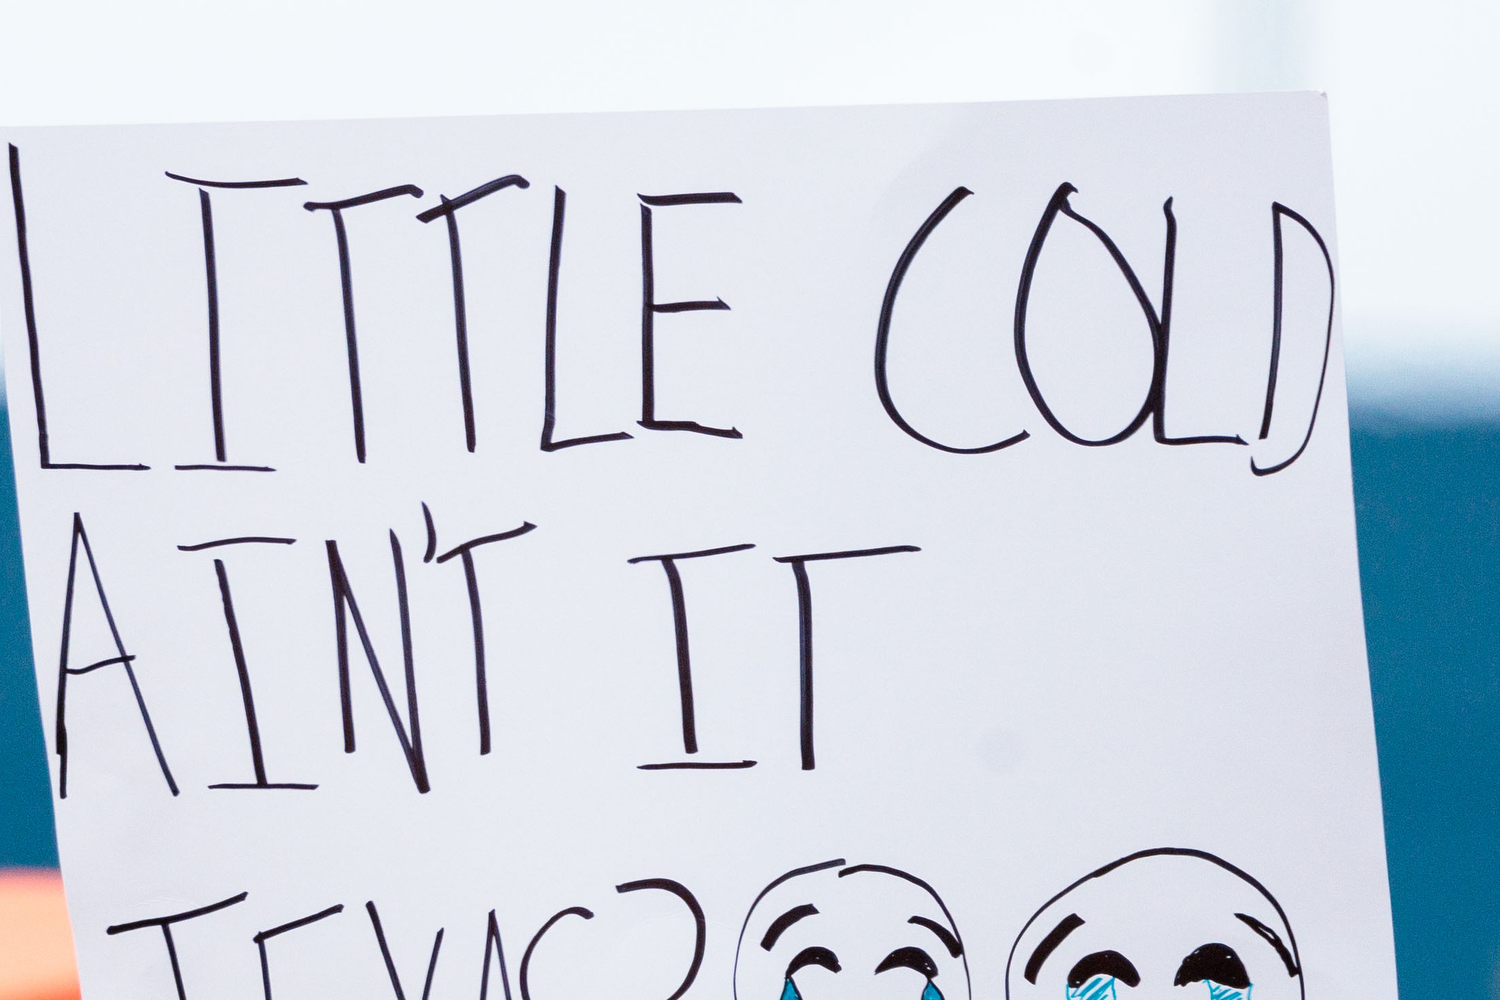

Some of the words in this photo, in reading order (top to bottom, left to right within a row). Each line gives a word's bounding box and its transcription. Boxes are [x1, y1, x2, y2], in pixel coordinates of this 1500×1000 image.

[9, 142, 743, 471] LITTLE
[875, 181, 1334, 477] COLD
[56, 501, 537, 799] AIN'T
[628, 543, 921, 771] IT
